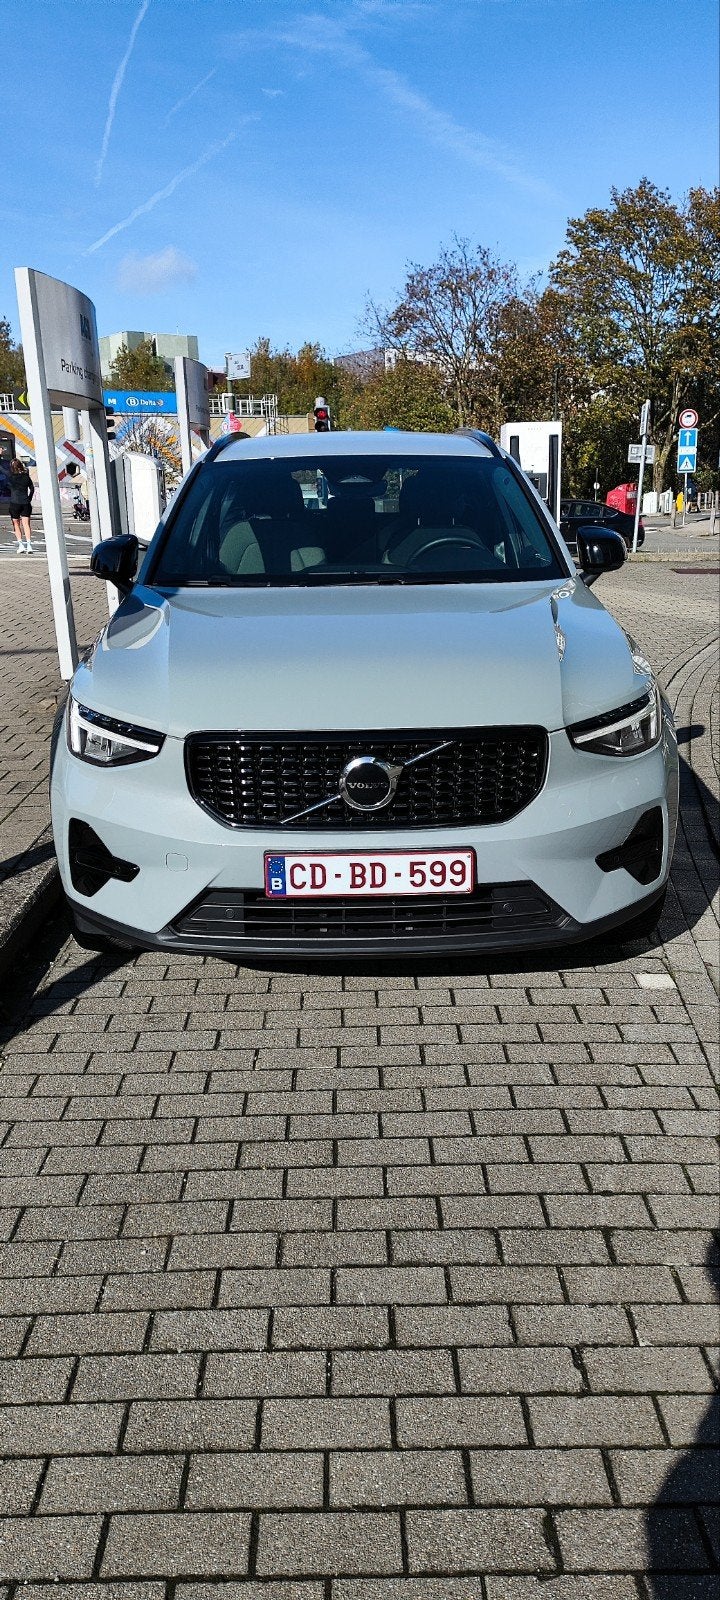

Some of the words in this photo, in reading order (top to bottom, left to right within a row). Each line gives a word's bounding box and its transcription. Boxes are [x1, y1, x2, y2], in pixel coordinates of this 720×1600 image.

[61, 358, 84, 380] Parking
[140, 398, 156, 406] Delta
[271, 877, 283, 891] B
